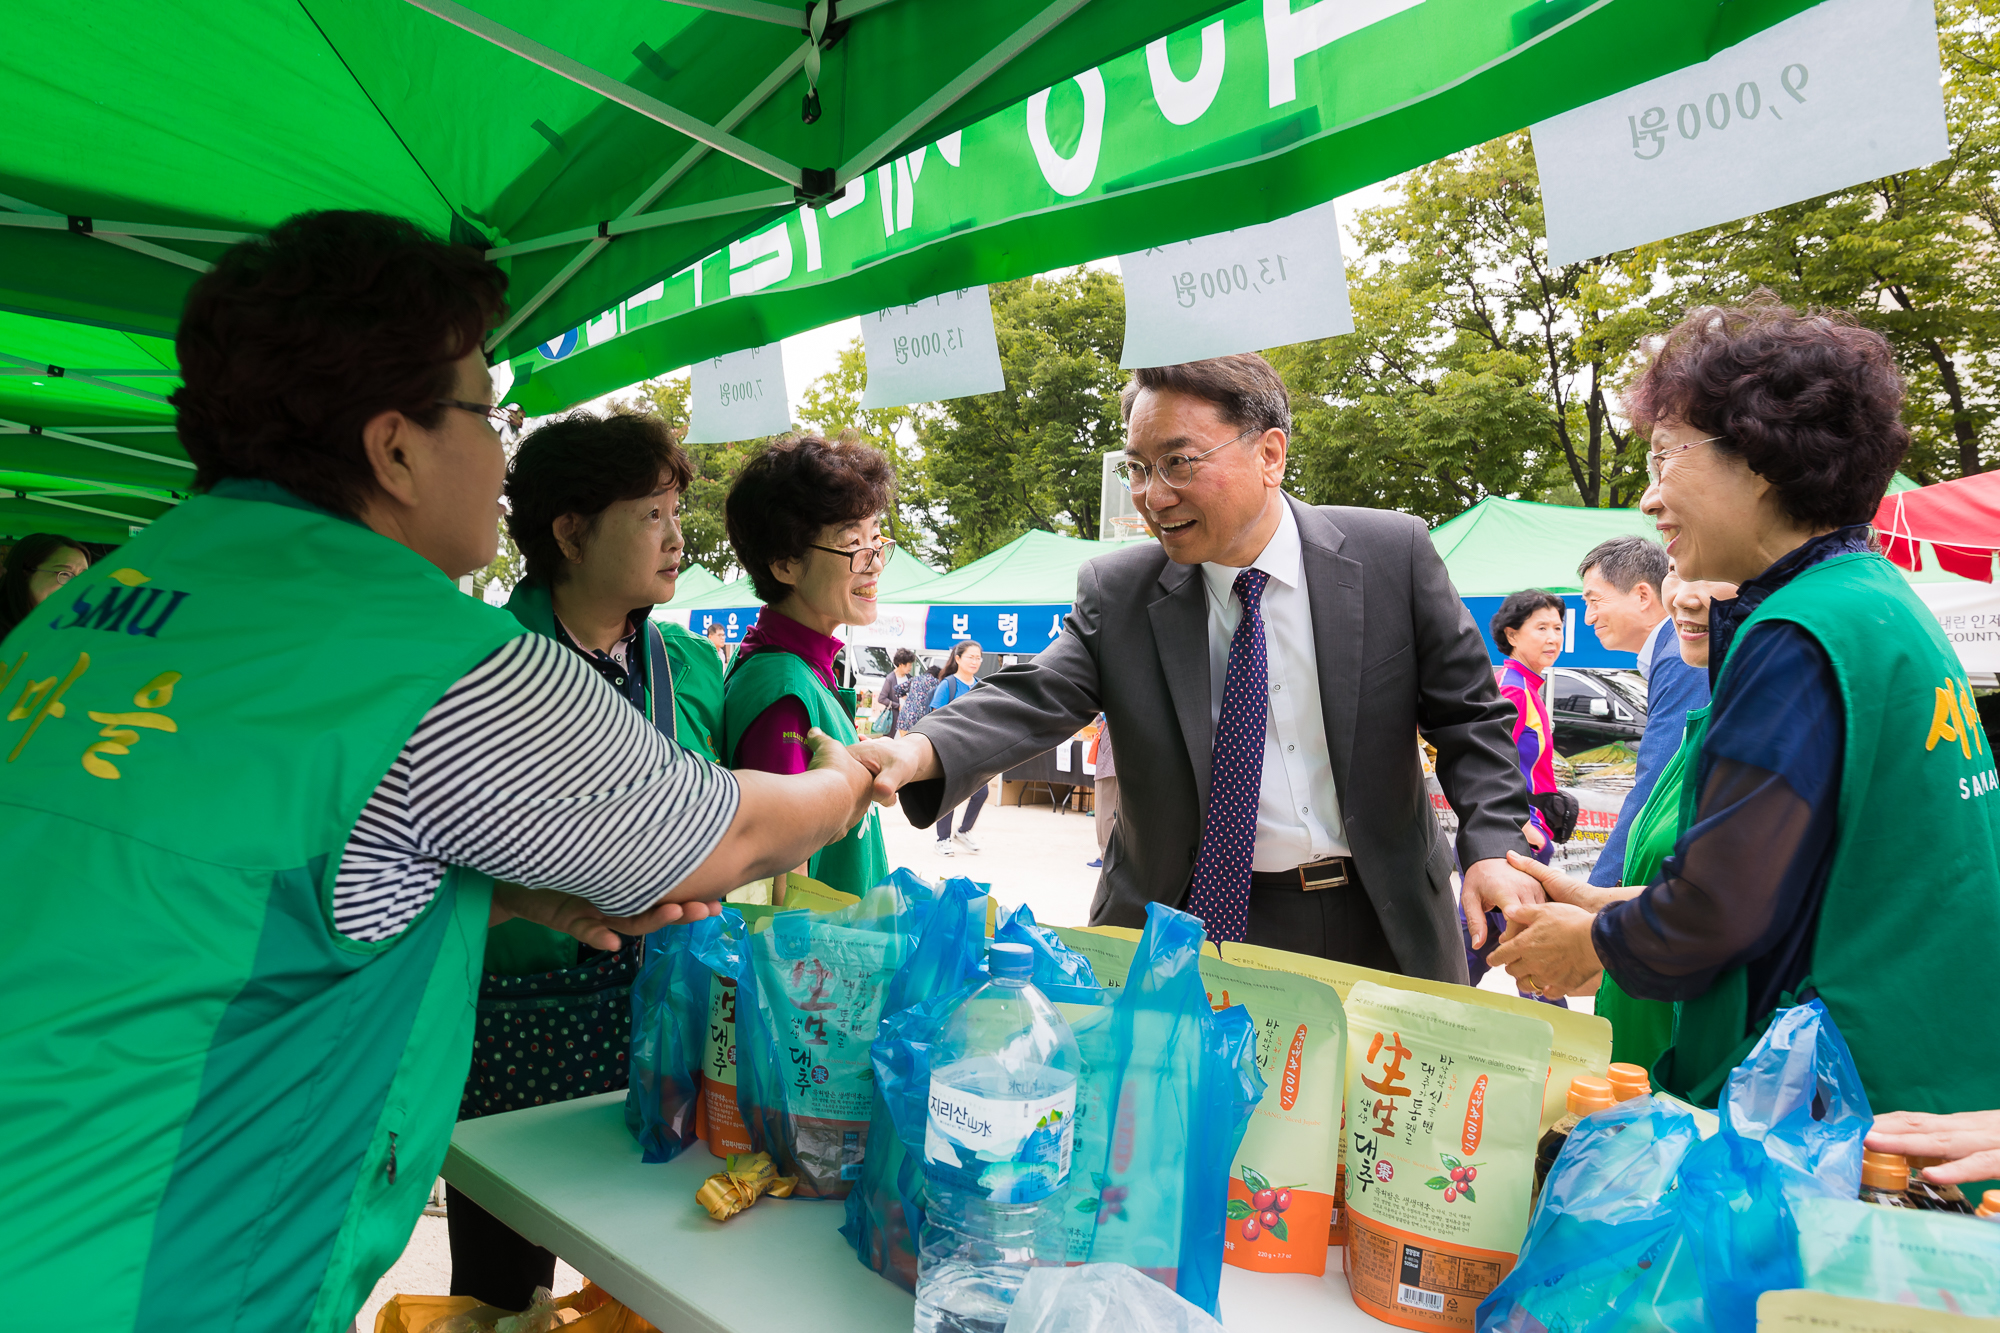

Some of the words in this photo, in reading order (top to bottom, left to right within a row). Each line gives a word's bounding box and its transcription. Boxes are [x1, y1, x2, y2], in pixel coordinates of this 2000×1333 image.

[711, 1024, 728, 1078] 대추
[1262, 1018, 1280, 1052] 바삭바삭
[789, 1047, 812, 1096] 대추
[1438, 1054, 1454, 1088] 바삭바삭
[1358, 1098, 1372, 1124] 생생
[1354, 1132, 1378, 1192] 대추
